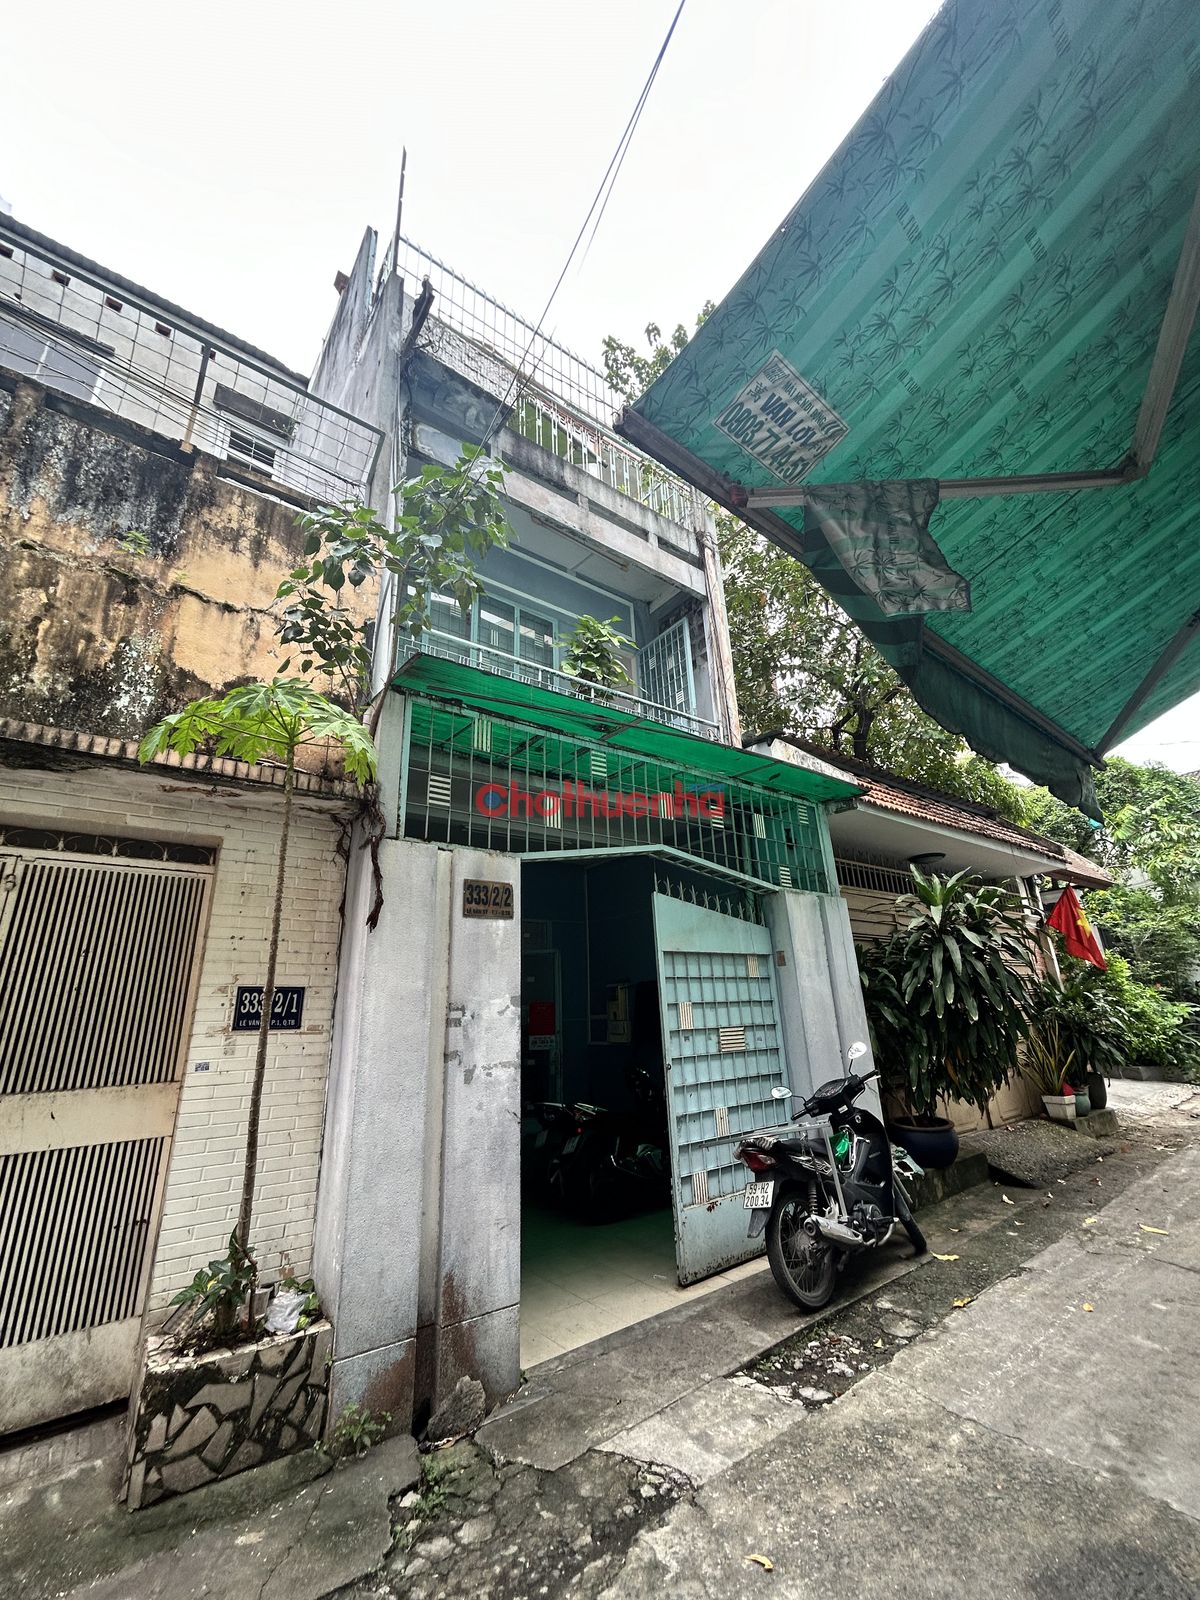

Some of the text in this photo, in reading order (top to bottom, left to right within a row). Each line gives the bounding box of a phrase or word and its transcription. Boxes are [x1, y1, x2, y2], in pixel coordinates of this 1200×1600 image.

[466, 884, 512, 909] 333/2/2
[748, 1182, 770, 1195] 59-H2
[745, 1195, 770, 1208] 200.34
